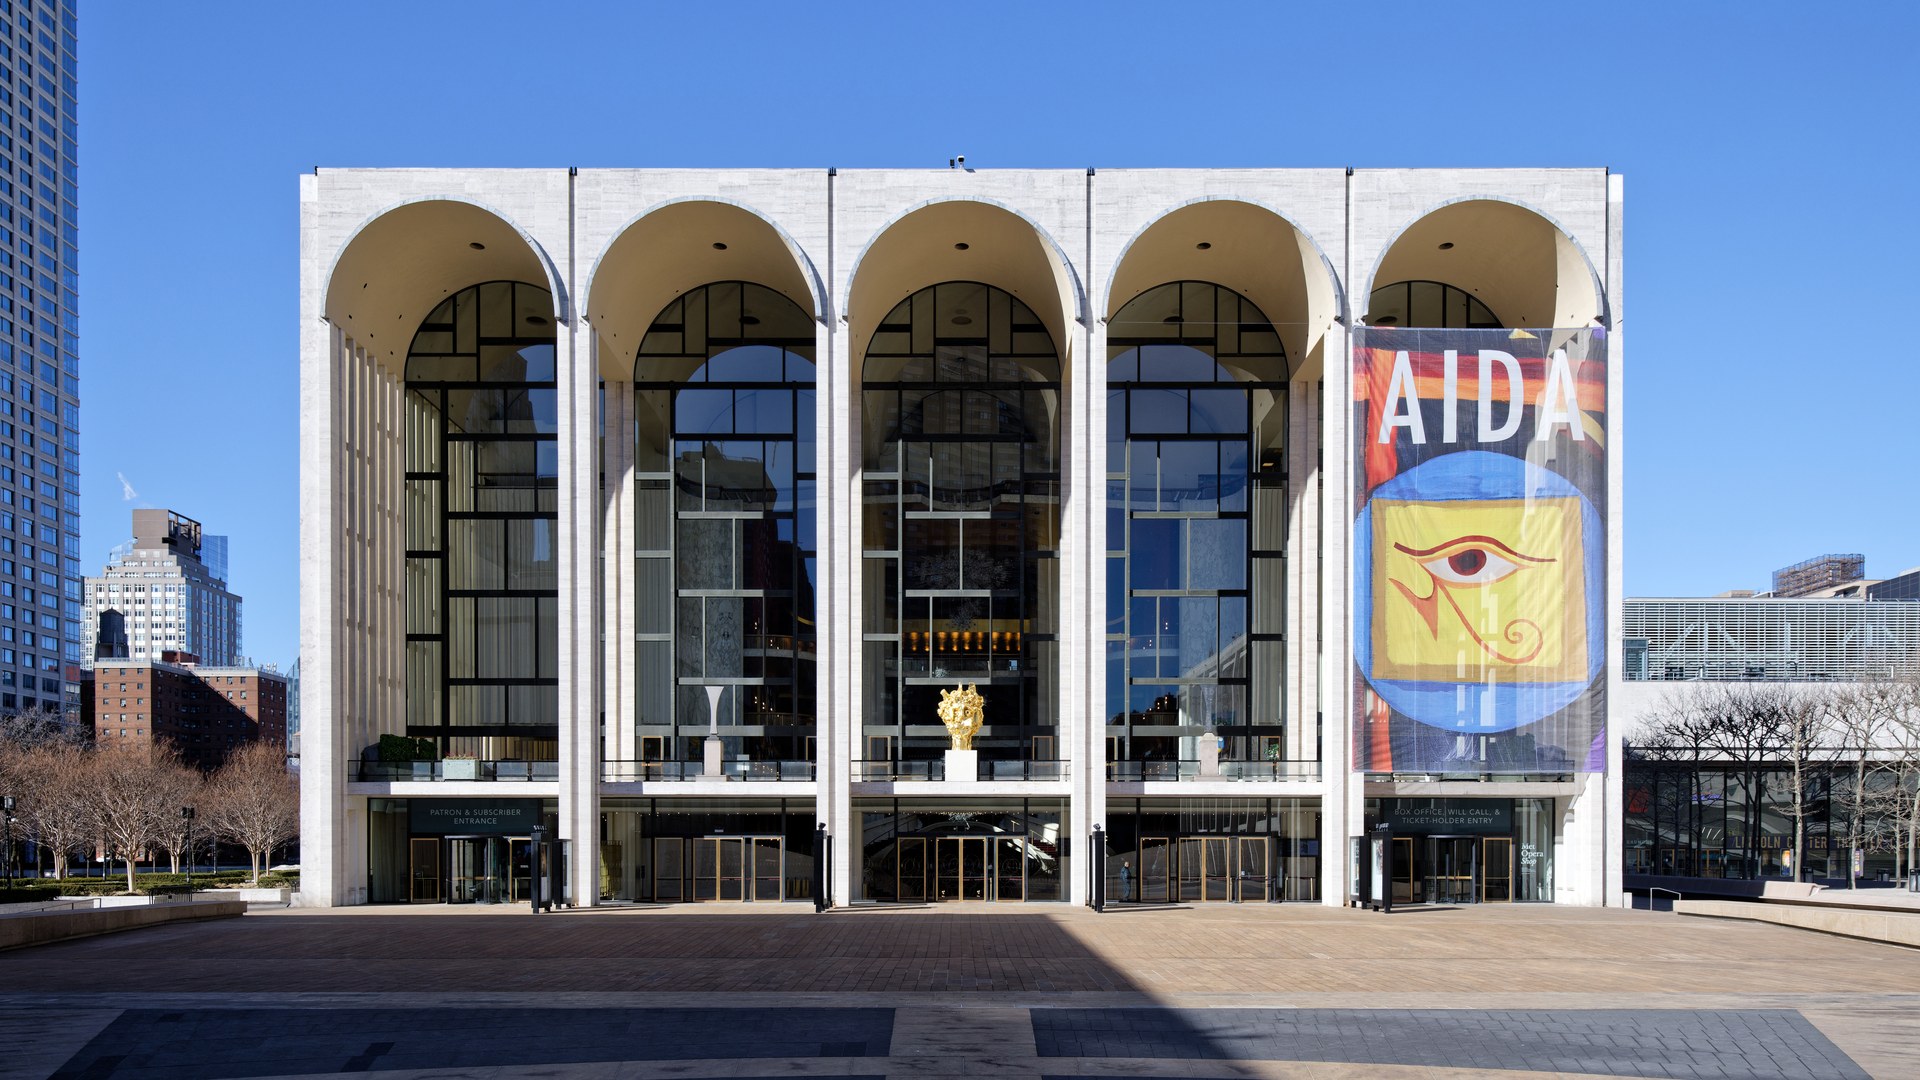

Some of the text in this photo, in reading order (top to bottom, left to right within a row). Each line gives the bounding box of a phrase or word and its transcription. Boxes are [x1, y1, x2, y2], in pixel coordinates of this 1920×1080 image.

[1378, 349, 1585, 444] AIDA
[430, 808, 521, 816] PATRON & SUBSCRIBER
[1394, 808, 1501, 817] BOX OFFICE, WILL CALL, &
[453, 817, 498, 825] ENTRANCE
[1521, 842, 1536, 850] Met
[1786, 836, 1828, 849] CTER
[1521, 849, 1544, 859] Opera
[1520, 857, 1537, 867] Shop
